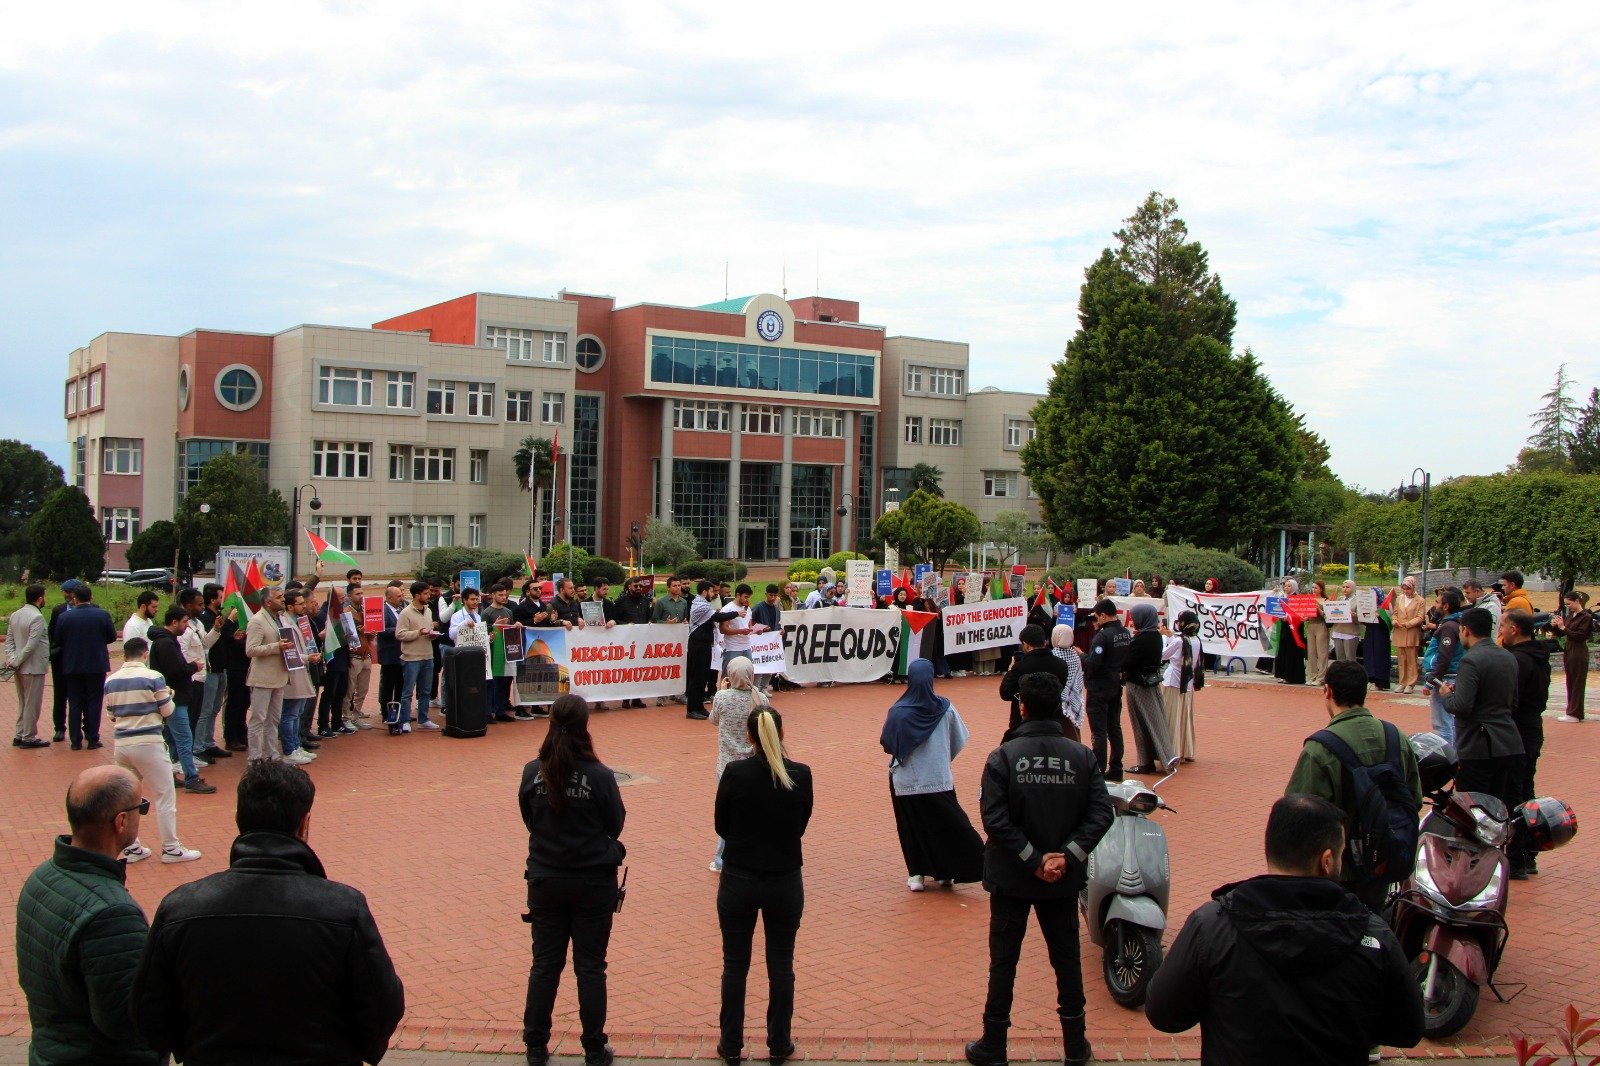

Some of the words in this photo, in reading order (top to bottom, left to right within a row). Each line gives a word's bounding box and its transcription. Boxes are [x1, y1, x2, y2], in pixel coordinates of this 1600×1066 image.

[224, 550, 263, 558] Ramazan
[945, 613, 966, 626] STOP
[967, 611, 982, 623] THE
[983, 605, 1024, 620] GENOCIDE
[955, 632, 966, 645] IN
[967, 629, 985, 643] THE
[986, 624, 1013, 641] GAZA
[570, 641, 636, 662] MESCİD-İ
[643, 642, 684, 659] AKSA
[573, 664, 681, 686] ONURUMUZDUR
[1015, 756, 1077, 775] ÖZEL
[533, 769, 592, 791] ÖEL
[1016, 772, 1076, 784] GÜVENLİK
